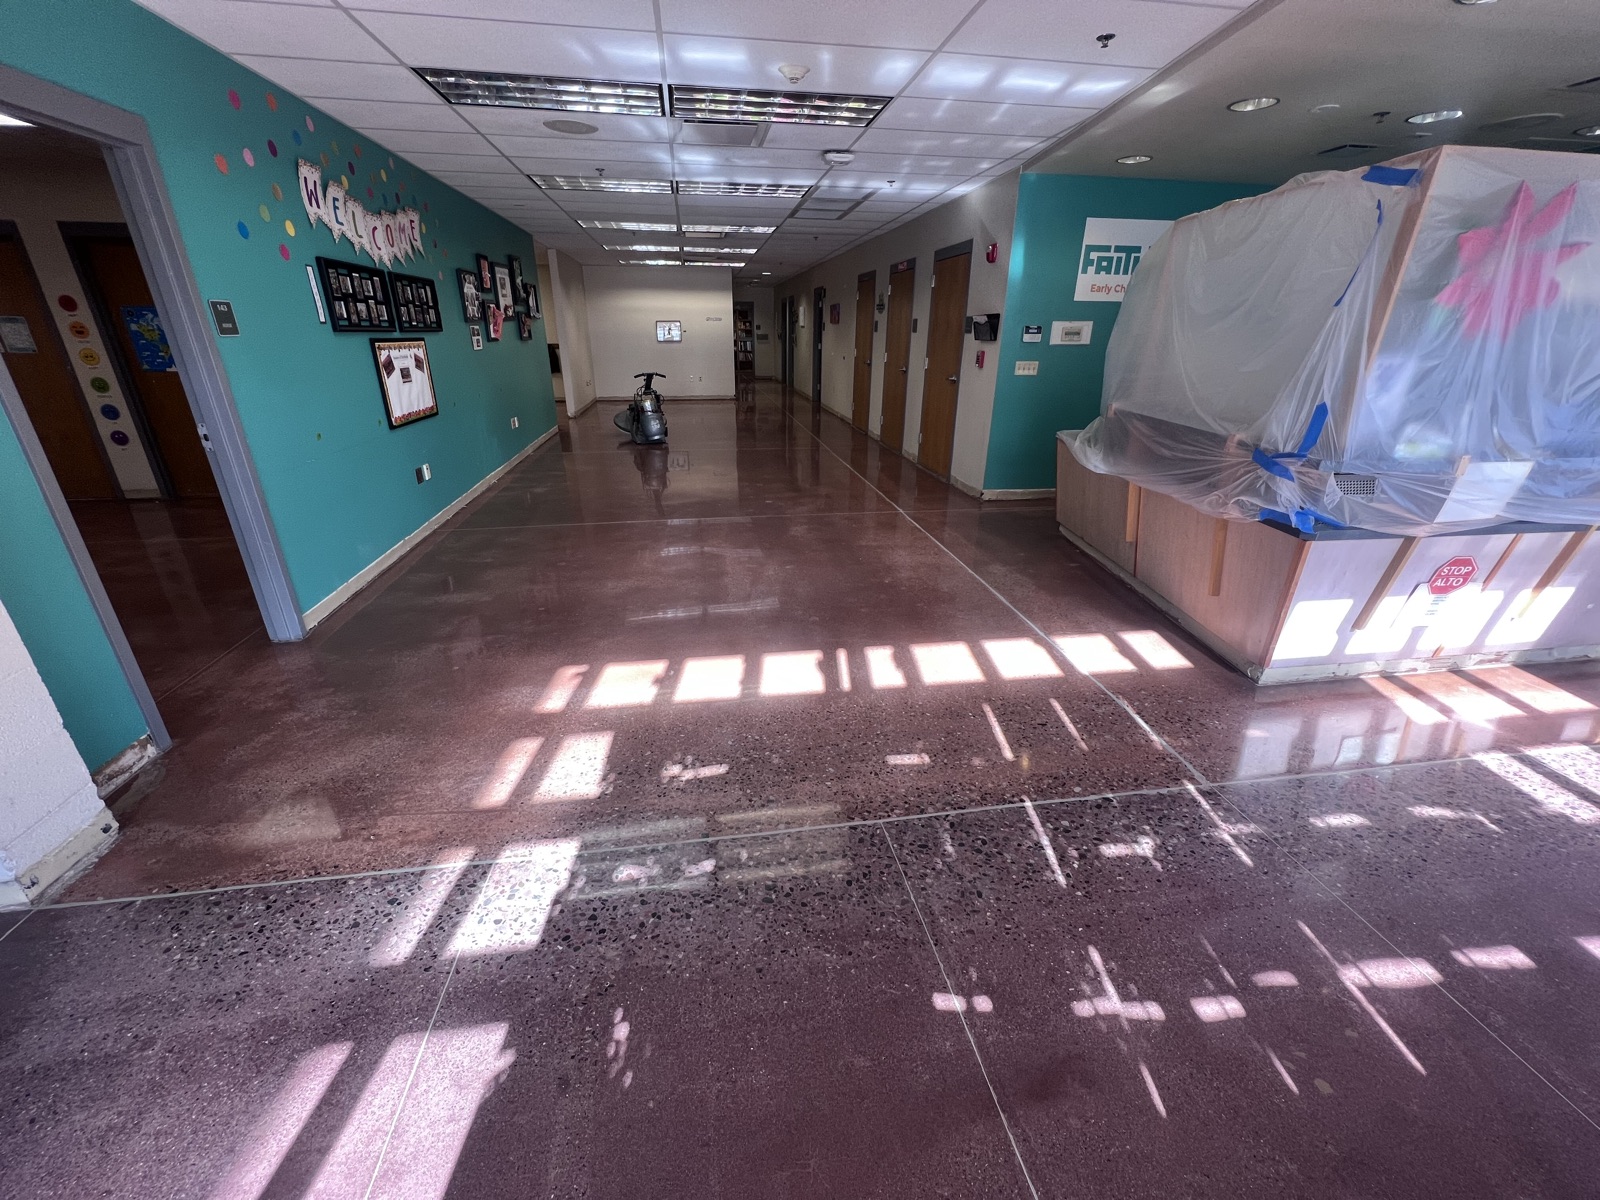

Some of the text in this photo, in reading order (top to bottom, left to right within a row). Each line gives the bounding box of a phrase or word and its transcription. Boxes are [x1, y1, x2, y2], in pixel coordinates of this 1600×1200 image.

[304, 176, 418, 251] WELCOME
[1090, 284, 1112, 295] Early
[1441, 566, 1473, 575] STOP
[1433, 578, 1463, 587] ALTO
